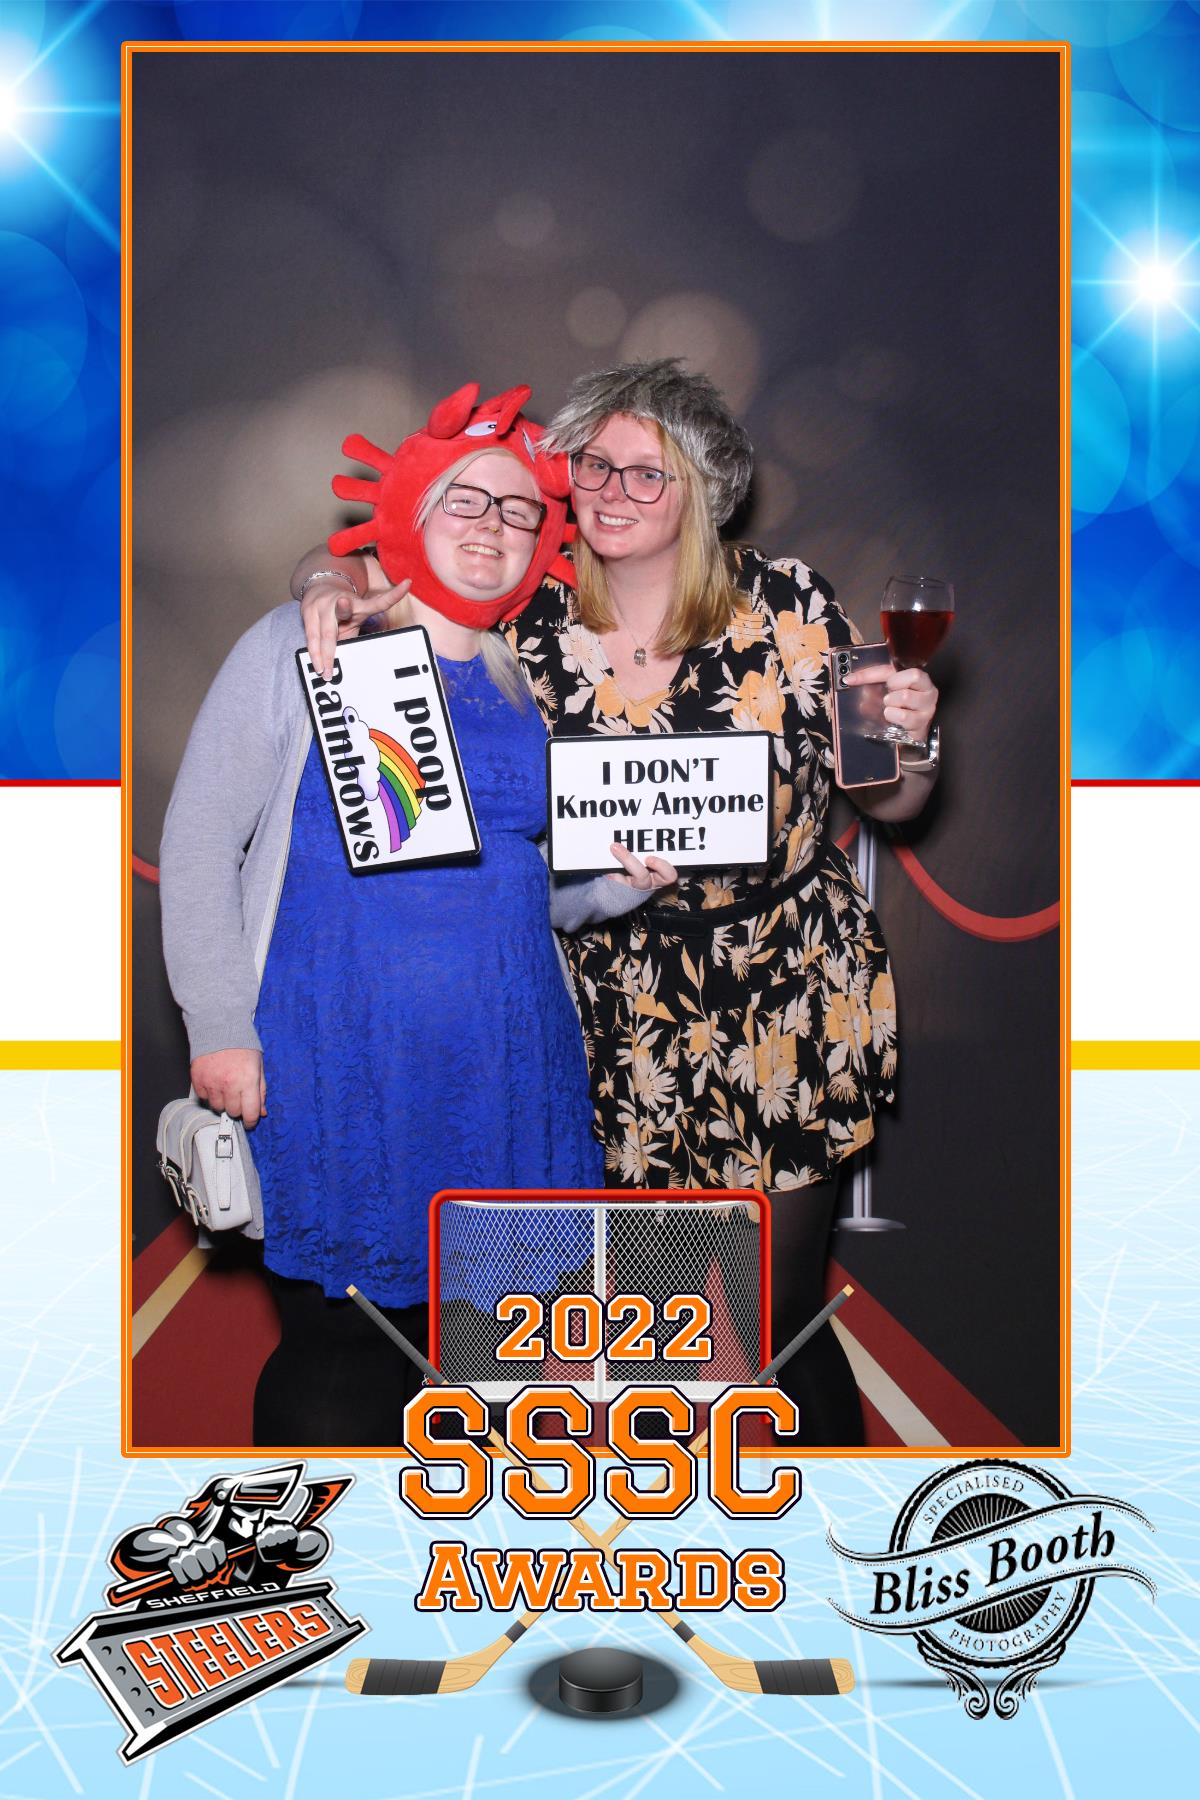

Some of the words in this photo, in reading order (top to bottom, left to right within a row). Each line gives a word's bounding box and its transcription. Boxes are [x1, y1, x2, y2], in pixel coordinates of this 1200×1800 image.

[394, 664, 429, 679] i
[307, 658, 379, 862] Rainbows
[394, 697, 452, 811] poop
[602, 761, 611, 785] I
[624, 758, 719, 784] DON’T
[556, 795, 642, 819] Know
[652, 791, 764, 820] Anyone
[613, 827, 706, 853] HERE!
